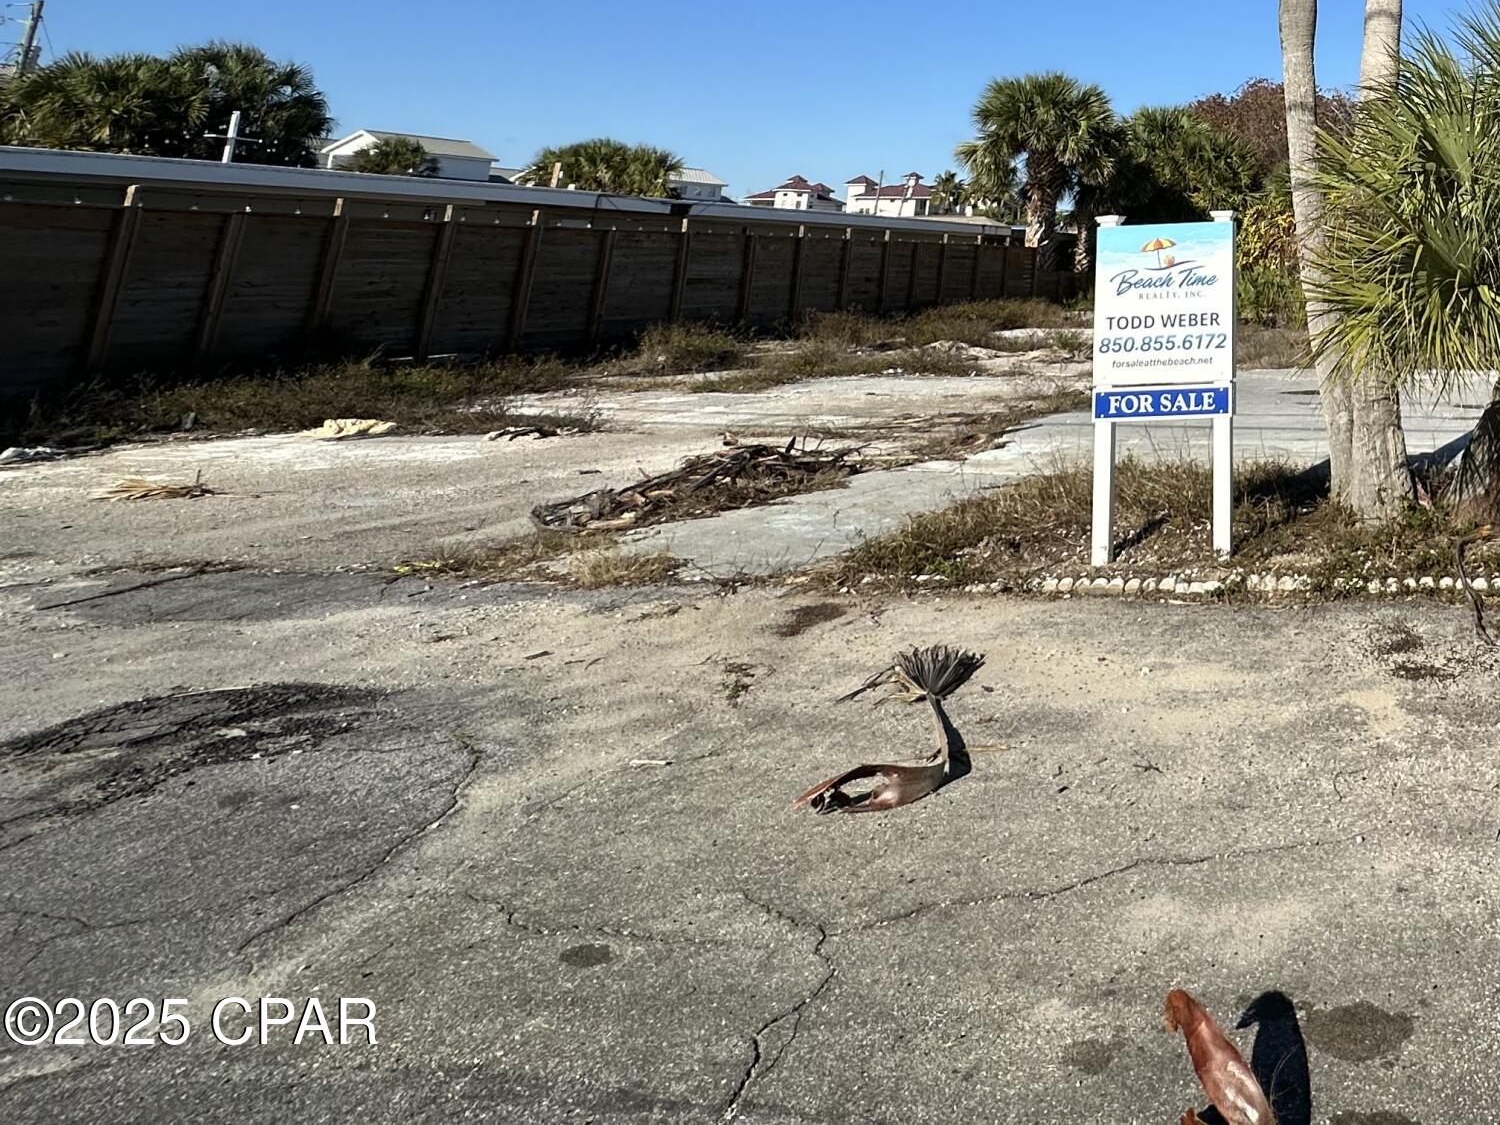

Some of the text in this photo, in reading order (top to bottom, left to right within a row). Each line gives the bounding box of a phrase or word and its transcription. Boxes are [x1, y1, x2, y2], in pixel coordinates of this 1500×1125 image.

[1109, 265, 1218, 296] Beach Time
[1106, 312, 1220, 330] TODD WEBER
[1099, 333, 1227, 353] 850.855.6172
[1112, 357, 1213, 368] forsaleatthebeach.net
[1108, 392, 1216, 414] FOR SALE
